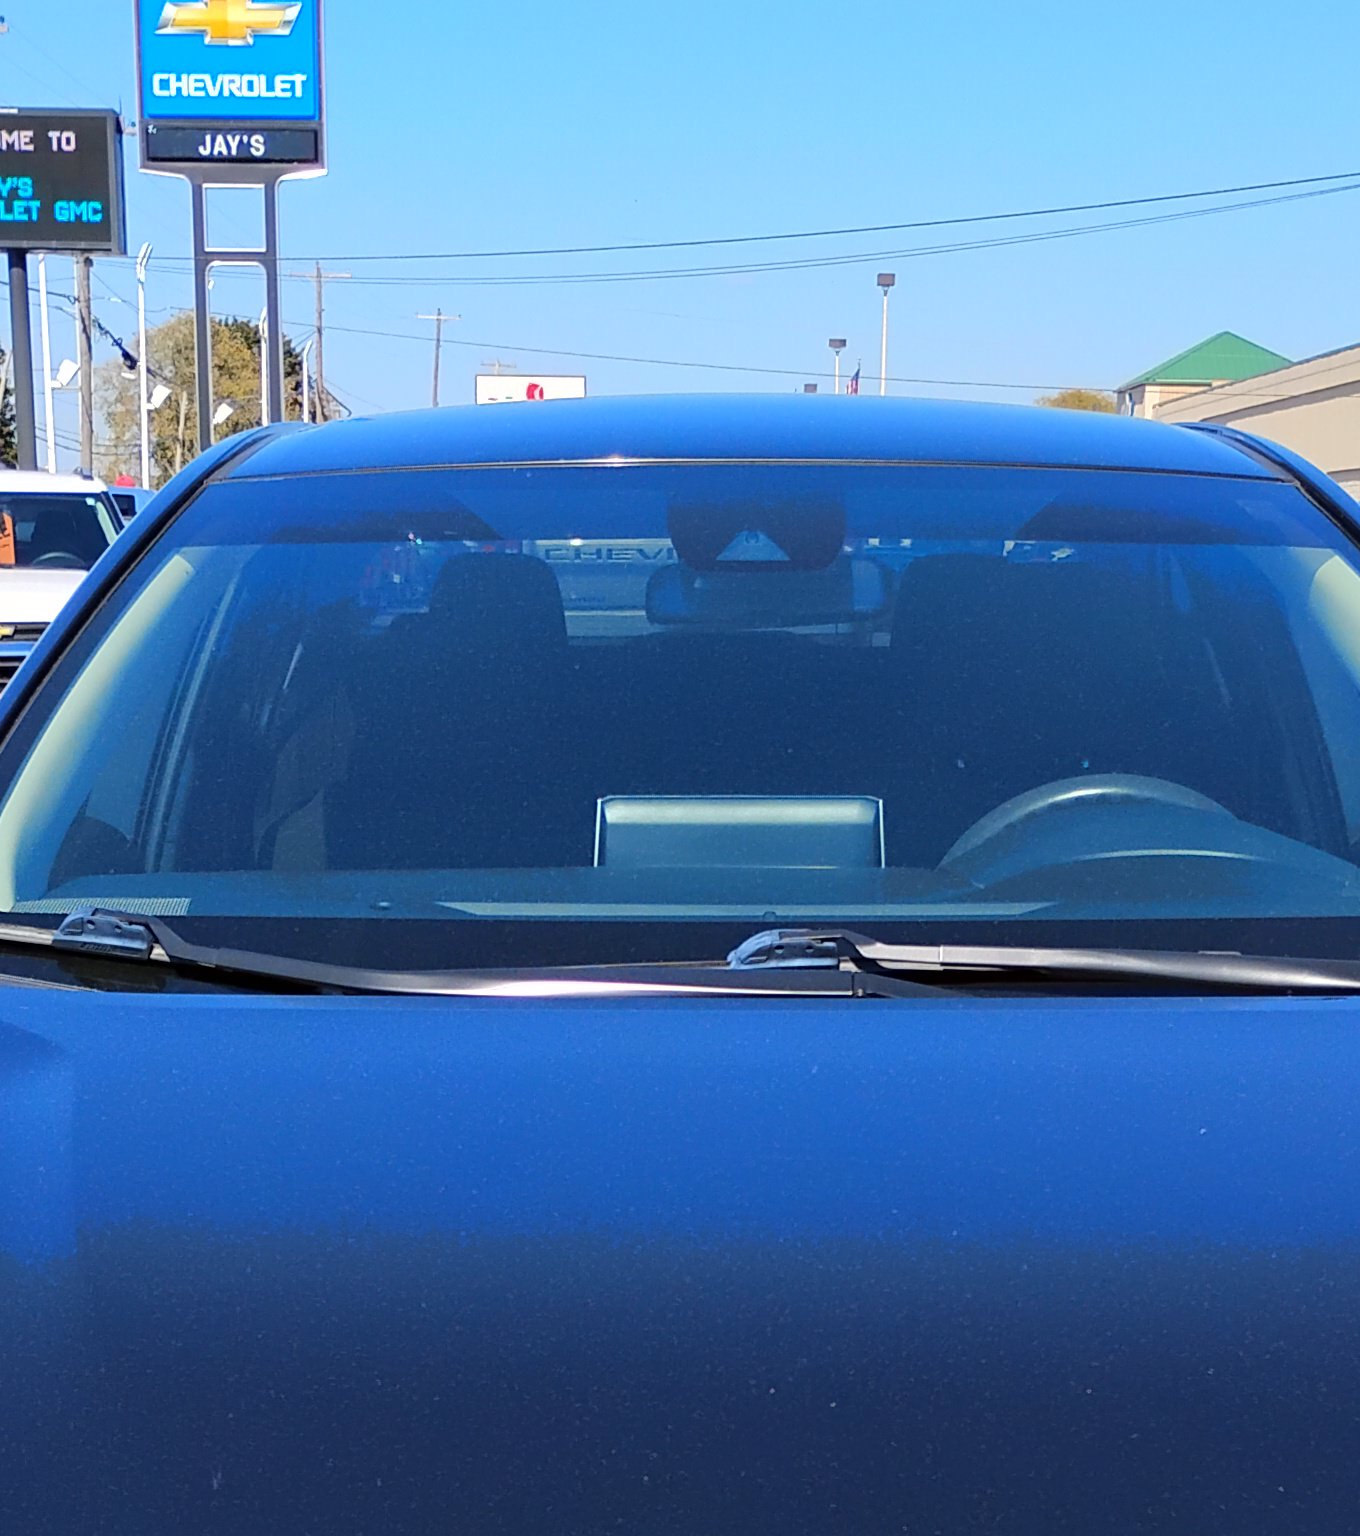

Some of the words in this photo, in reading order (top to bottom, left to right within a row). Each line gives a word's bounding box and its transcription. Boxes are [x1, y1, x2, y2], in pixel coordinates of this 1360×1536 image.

[152, 73, 307, 98] CHEVROLET
[48, 130, 76, 152] TO
[198, 134, 265, 156] JAY'S
[53, 201, 103, 223] GMC
[545, 547, 678, 563] CHEV
